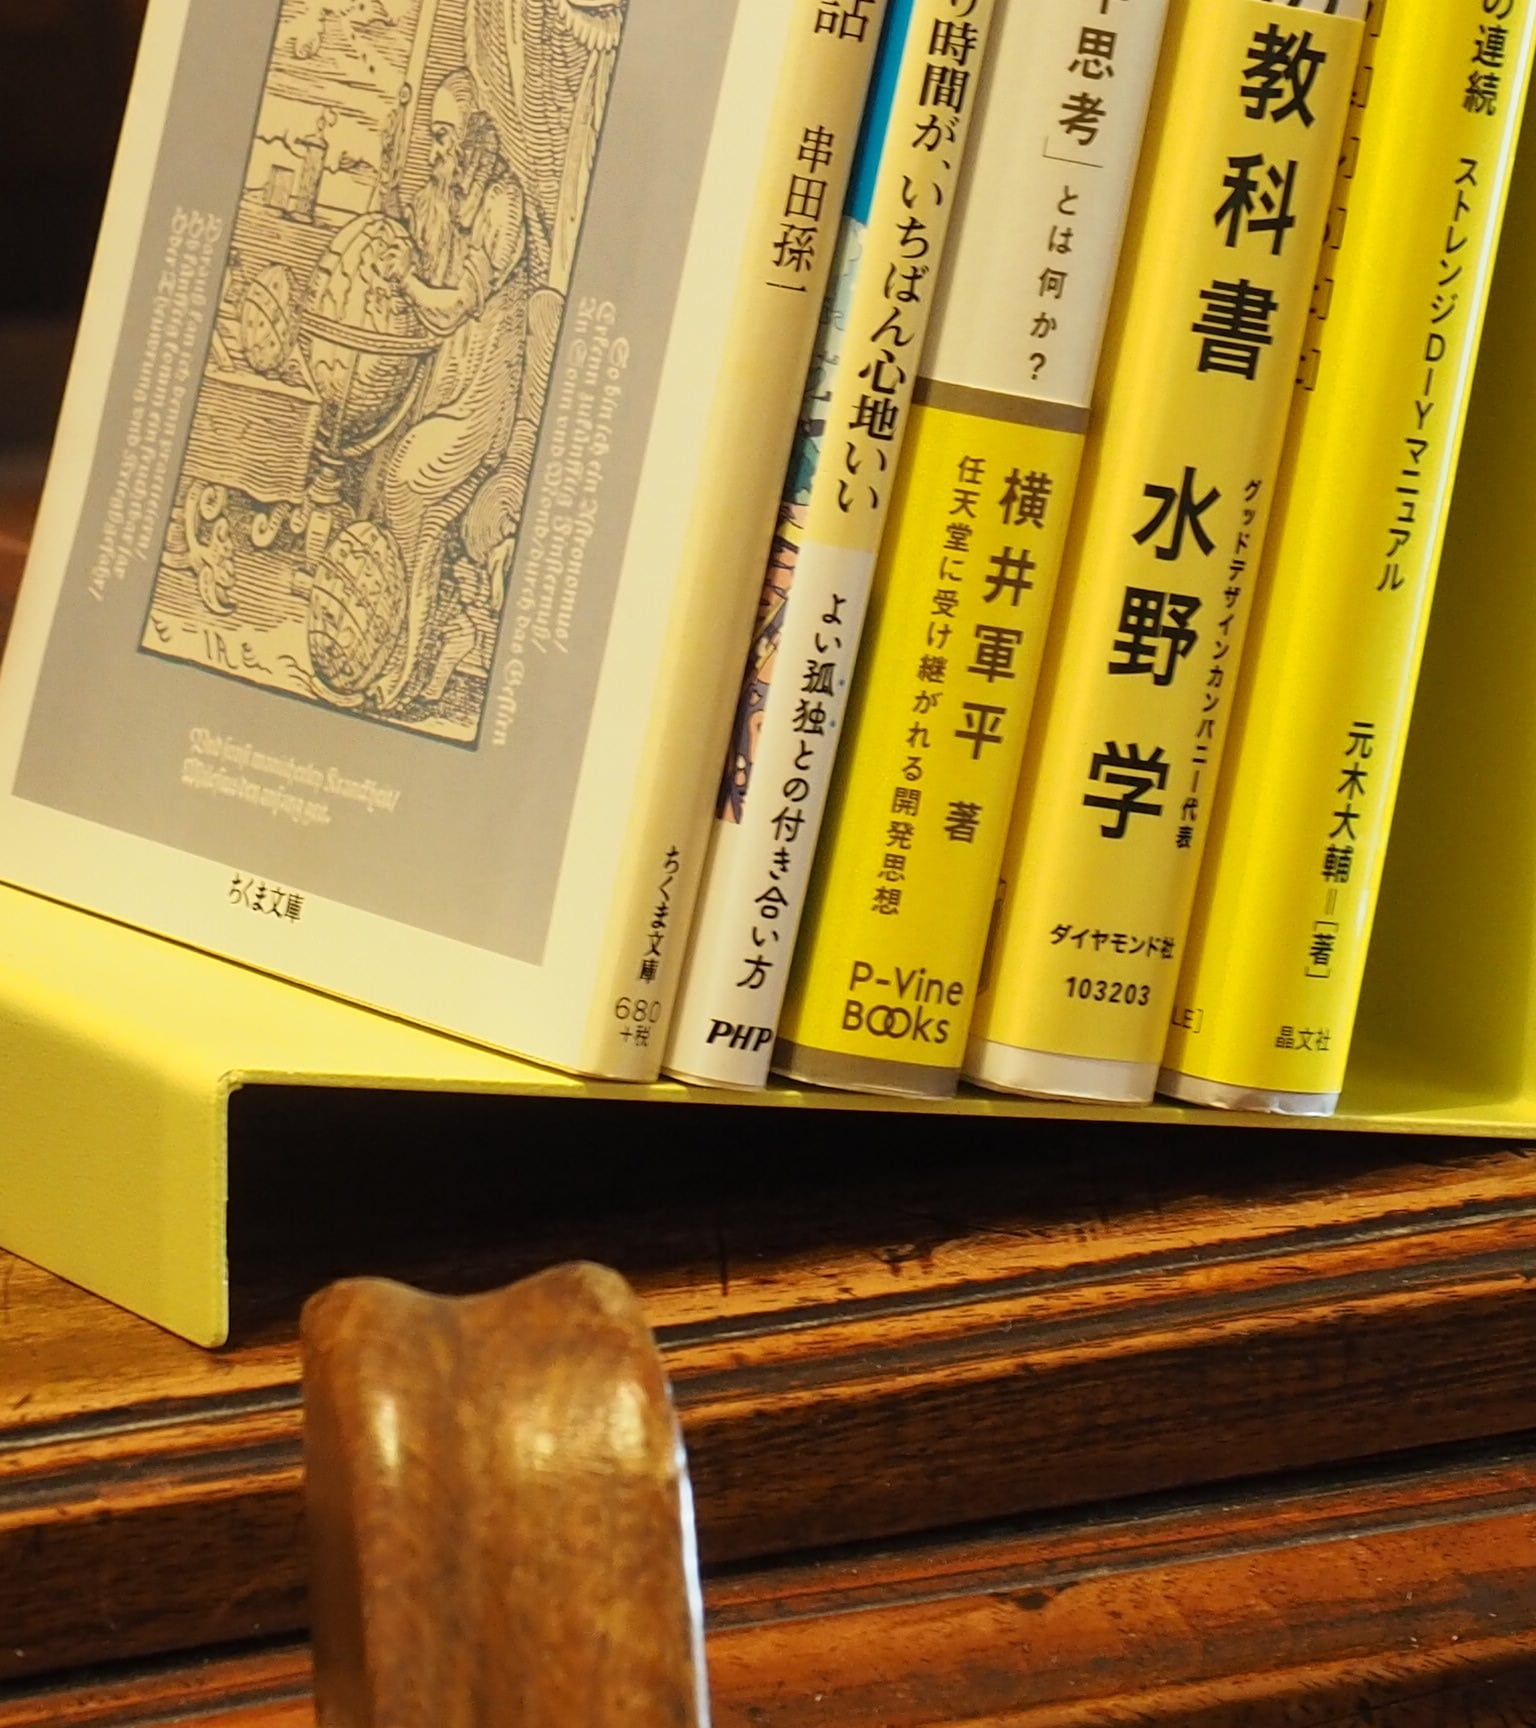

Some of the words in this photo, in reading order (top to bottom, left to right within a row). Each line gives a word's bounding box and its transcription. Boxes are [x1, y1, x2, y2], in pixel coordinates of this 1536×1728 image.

[765, 125, 836, 295] 串田孫一
[1376, 156, 1479, 594] ストレンジDIYマニュアル
[954, 466, 1054, 761] 横井軍平
[1082, 465, 1224, 842] 水野学
[870, 453, 987, 917] 任天堂に受け継がれる開発思想
[1175, 478, 1263, 850] グッドデザインカンパニー代表
[736, 592, 847, 991] よい孤独との付き合い方
[944, 800, 983, 845] 著
[226, 873, 306, 924] ちくま文庫
[638, 843, 680, 984] ちくま文庫
[1050, 923, 1176, 960] ダイヤモンド社
[614, 995, 661, 1026] 680
[849, 960, 965, 1007] P-Vine
[1065, 976, 1151, 1007] 103203
[705, 1017, 774, 1053] PHP
[1275, 1025, 1333, 1054] 晶文社
